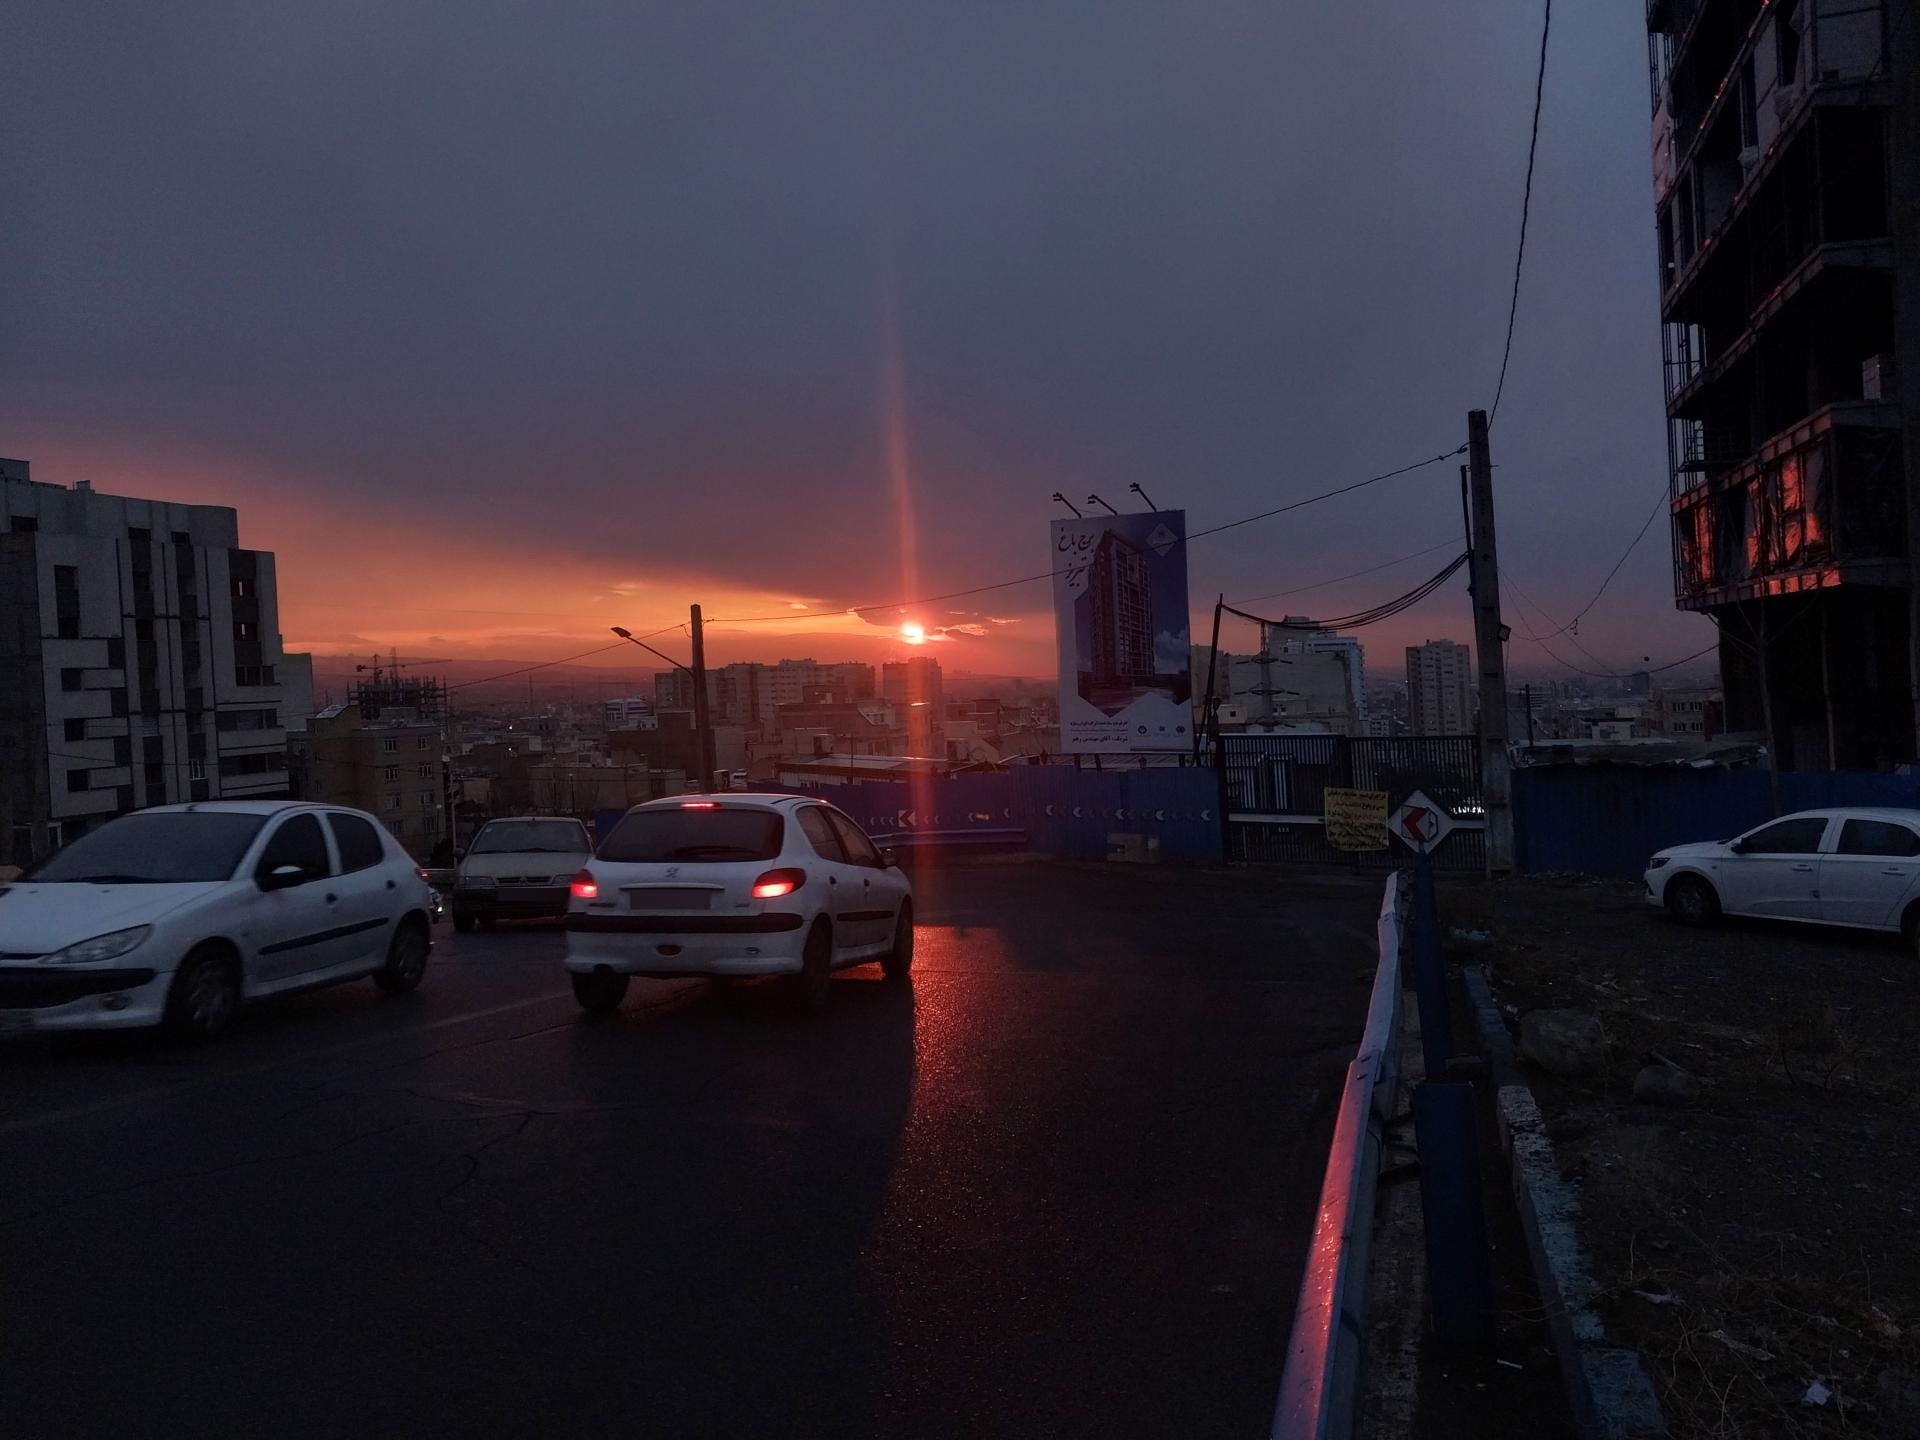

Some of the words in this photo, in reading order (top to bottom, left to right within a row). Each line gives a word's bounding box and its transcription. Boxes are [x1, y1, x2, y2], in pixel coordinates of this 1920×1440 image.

[1058, 527, 1078, 554] باغ
[1078, 534, 1095, 553] برج
[1065, 557, 1087, 587] تبریز
